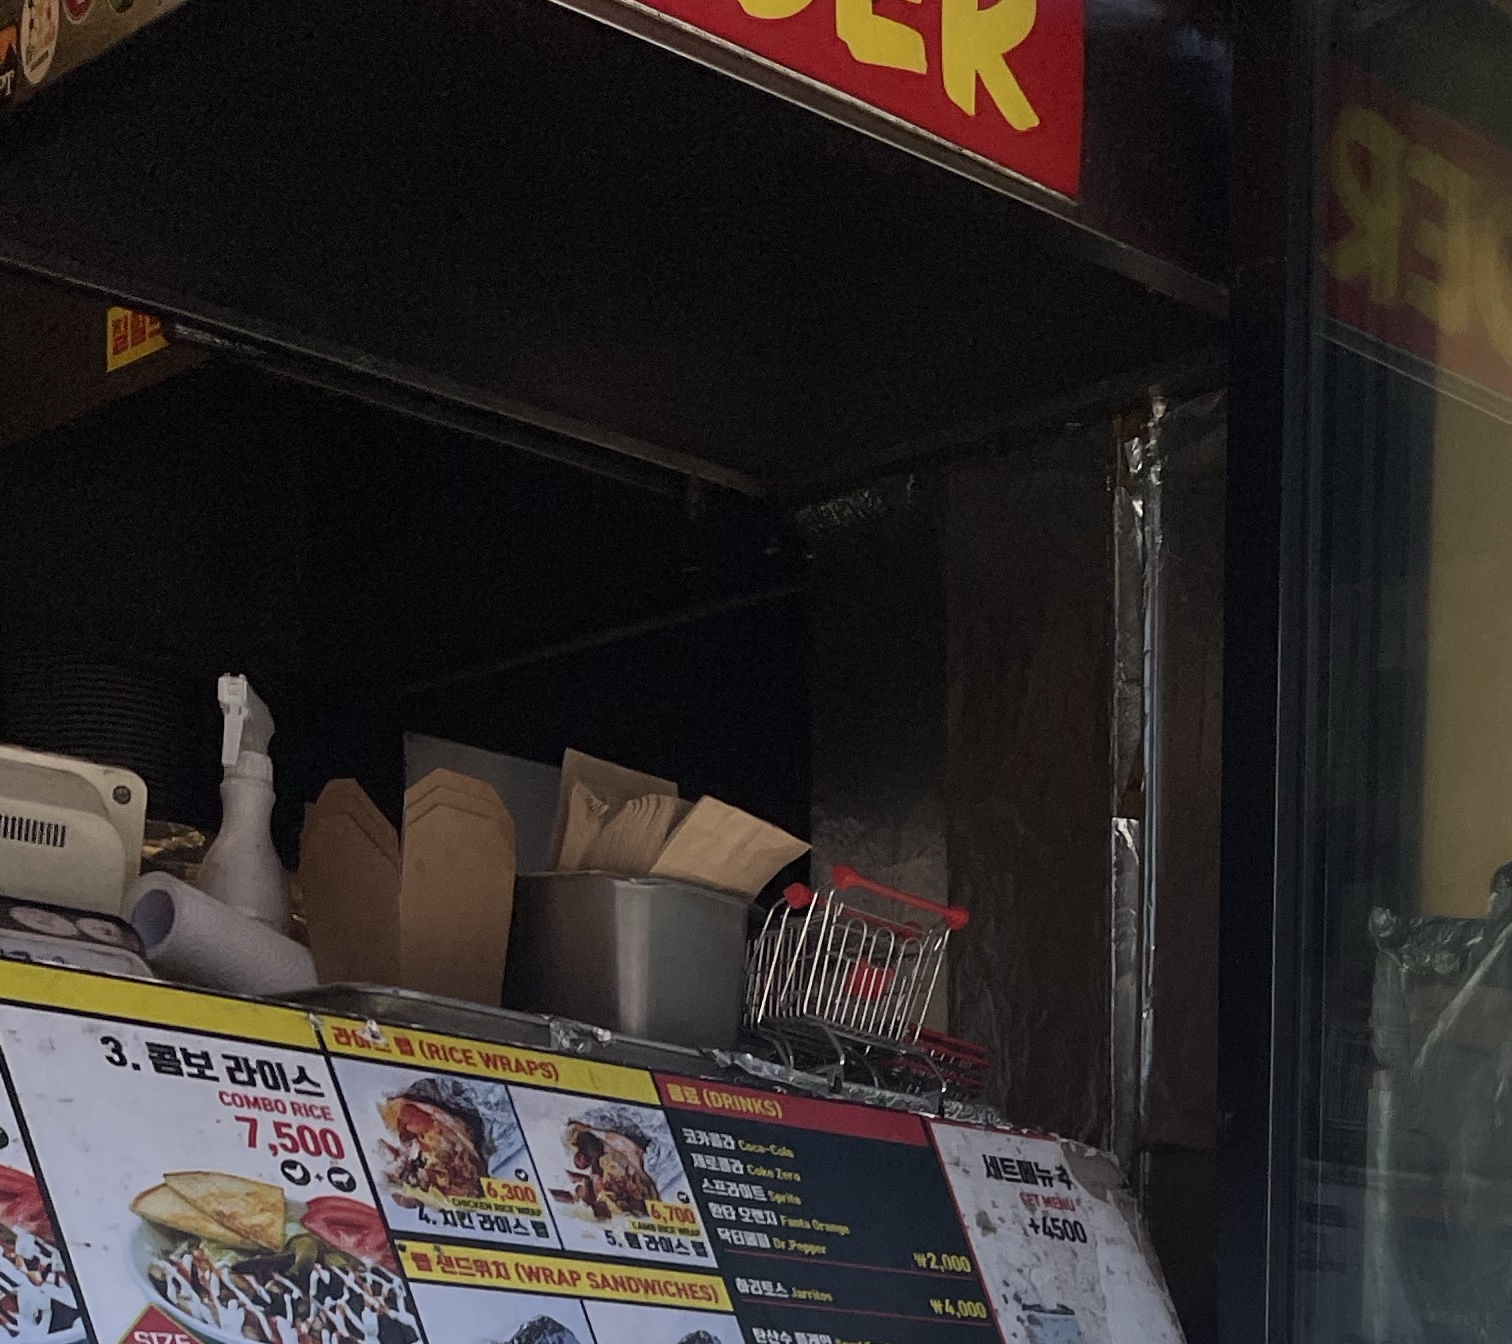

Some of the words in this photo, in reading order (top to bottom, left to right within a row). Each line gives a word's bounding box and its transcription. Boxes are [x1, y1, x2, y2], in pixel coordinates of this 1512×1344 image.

[100, 1035, 141, 1072] 3.
[145, 1041, 220, 1083] 콤보
[221, 1053, 325, 1098] 라이스
[419, 1039, 477, 1067] (RICE
[481, 1050, 560, 1083] WRAPS)
[218, 1090, 288, 1115] COMBO
[292, 1100, 335, 1122] RICE
[702, 1088, 783, 1119] (DRINKS)
[234, 1115, 346, 1160] 7,500
[486, 1181, 538, 1204] 6,300
[701, 1177, 767, 1202] 스프라이트
[441, 1208, 475, 1230] 치킨
[478, 1212, 530, 1237] 라이스
[650, 1203, 696, 1225] 6,700
[643, 1233, 690, 1254] 라이스
[1028, 1216, 1088, 1244] +4500
[912, 1252, 973, 1275] ₩2,000
[437, 1254, 509, 1281] 샌드위치
[516, 1261, 582, 1288] (WRAP
[588, 1272, 720, 1303] SANDWICHES)
[929, 1298, 988, 1319] ₩4,000
